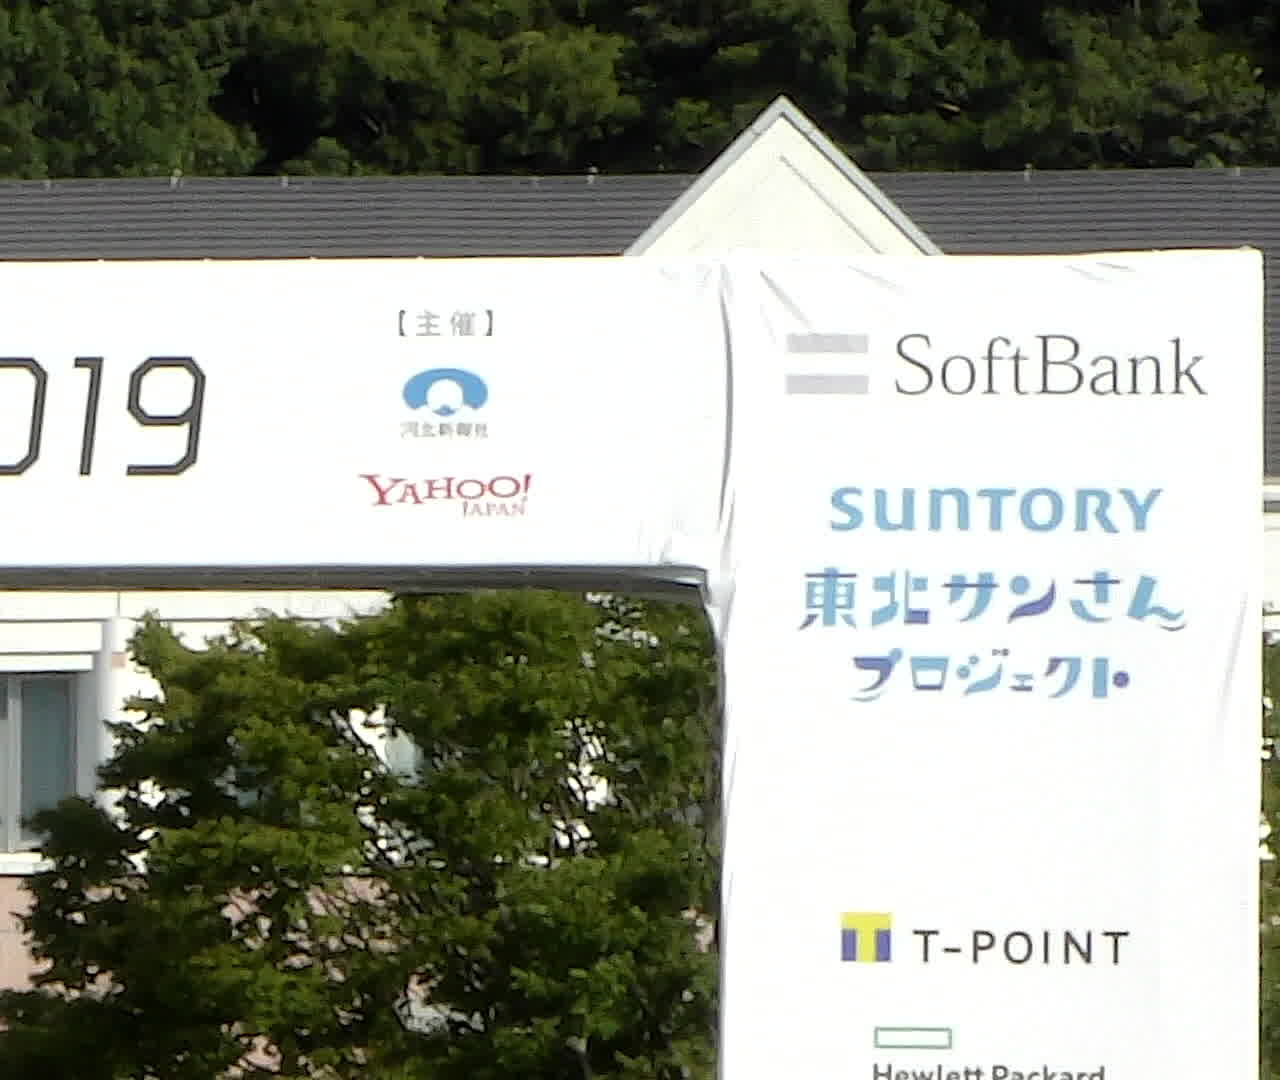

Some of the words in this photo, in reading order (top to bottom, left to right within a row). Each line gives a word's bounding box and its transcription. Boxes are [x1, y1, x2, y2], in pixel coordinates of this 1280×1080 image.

[895, 333, 1208, 397] SoftBank
[359, 473, 533, 506] YAHOO!
[463, 501, 526, 518] JAPAN
[830, 486, 1164, 535] SUNTORY
[799, 567, 1187, 632] 東北サンさん
[852, 648, 1131, 703] プロジェクト
[913, 928, 1131, 966] T-POINT
